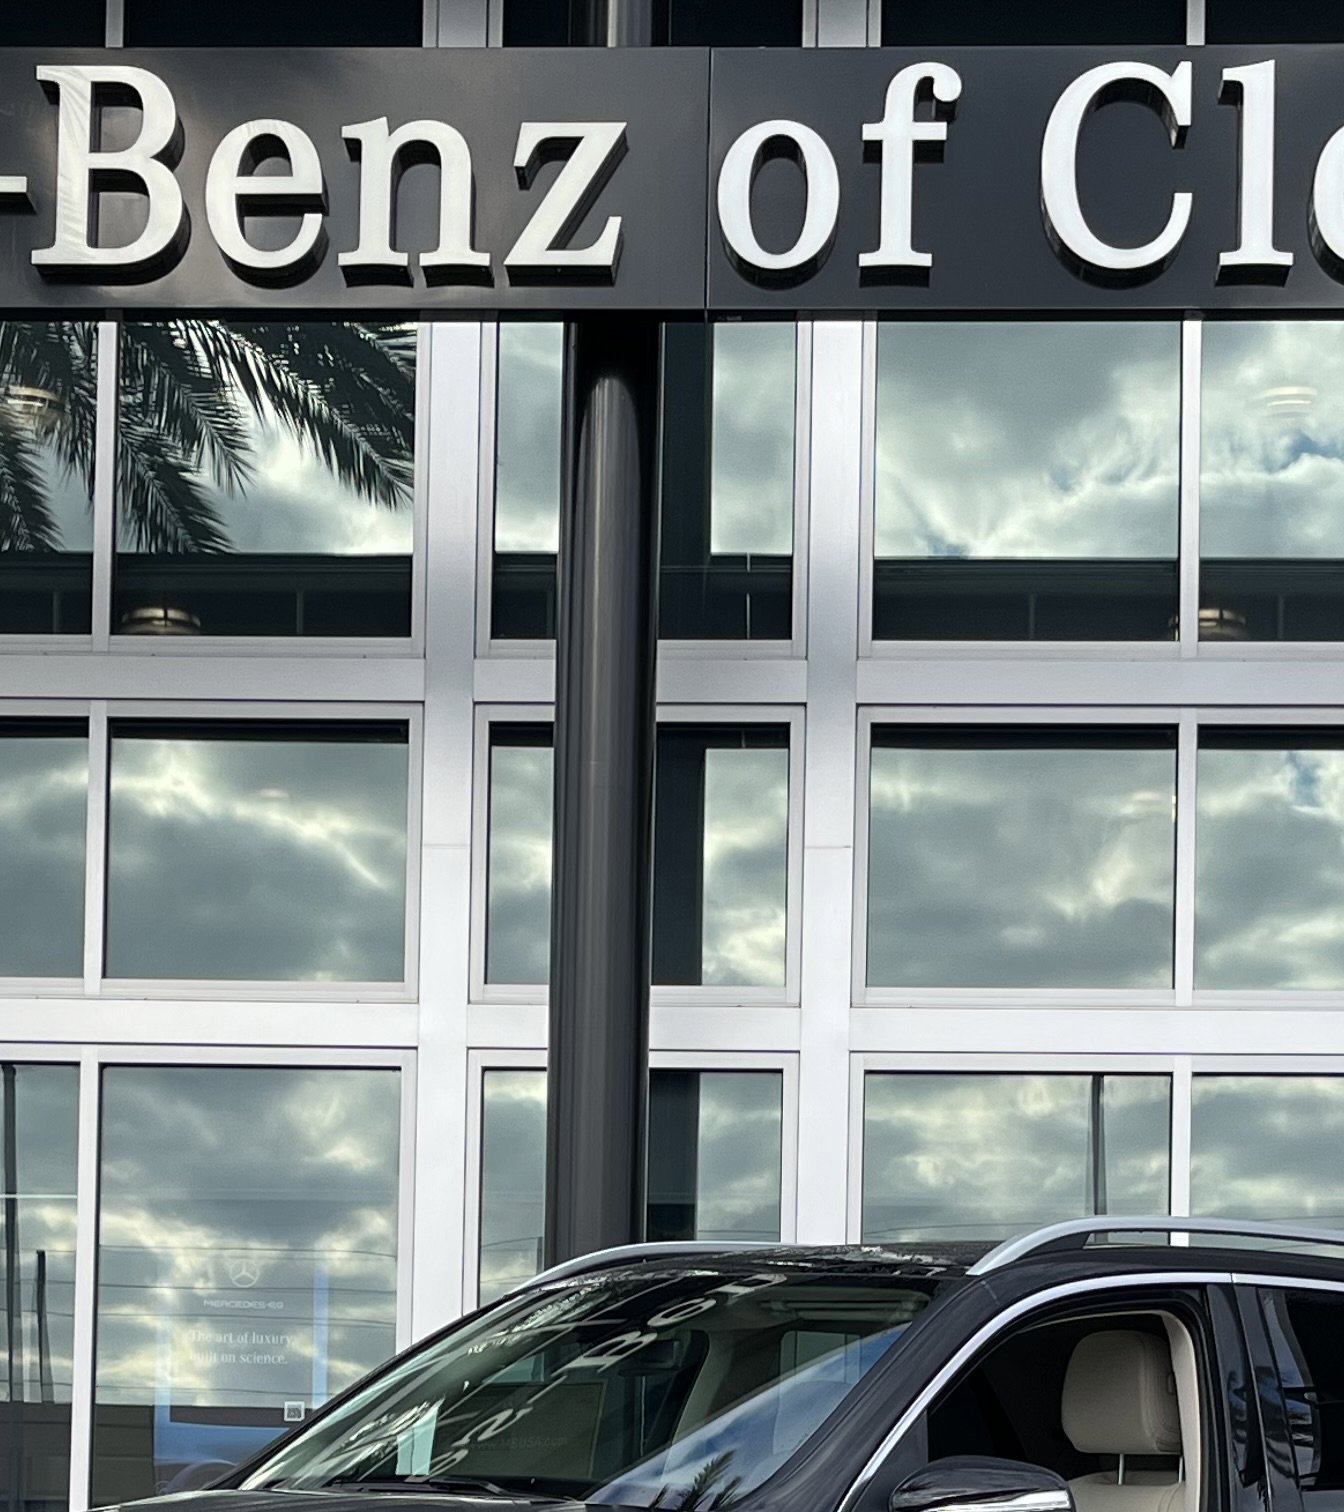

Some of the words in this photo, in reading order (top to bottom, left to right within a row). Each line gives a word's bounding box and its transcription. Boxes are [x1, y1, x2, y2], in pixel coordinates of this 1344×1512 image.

[717, 61, 962, 272] of
[215, 1332, 233, 1344] art
[237, 1331, 250, 1344] of
[220, 1354, 236, 1363] on
[240, 1351, 288, 1364] science.
